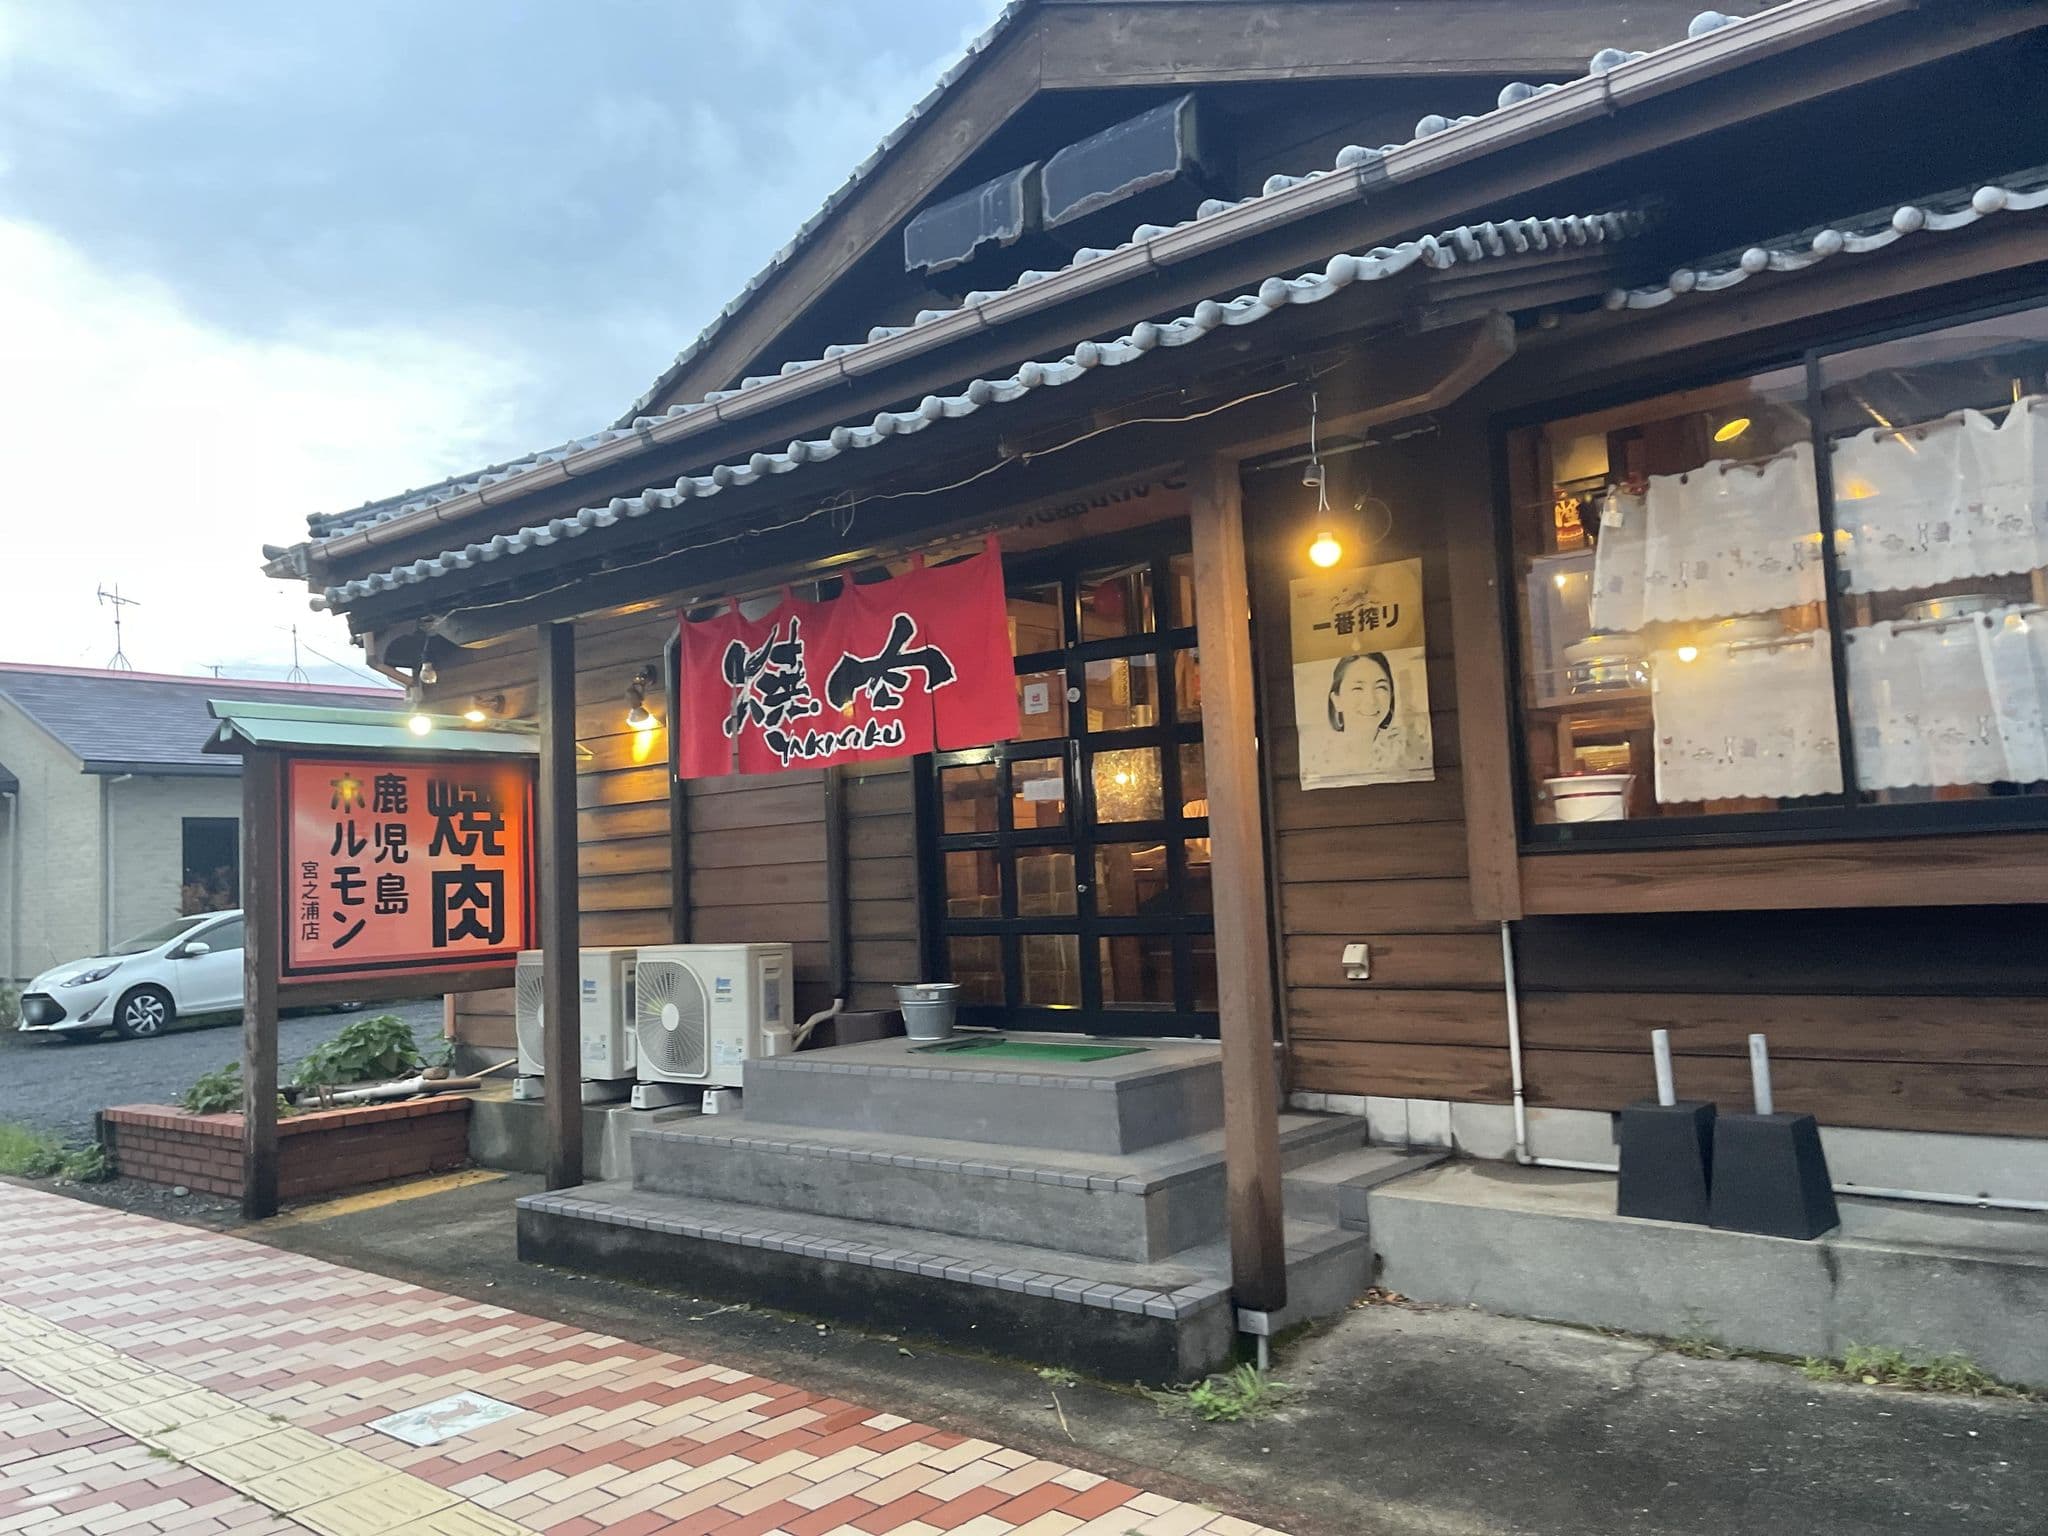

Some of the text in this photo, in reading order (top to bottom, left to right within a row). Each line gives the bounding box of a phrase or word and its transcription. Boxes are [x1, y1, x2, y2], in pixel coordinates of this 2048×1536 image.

[1313, 603, 1399, 635] 一番搾り
[301, 861, 320, 941] 宮之浦店
[331, 773, 367, 949] ホルモン
[373, 773, 408, 914] 鹿児島
[427, 776, 505, 947] 焼肉
